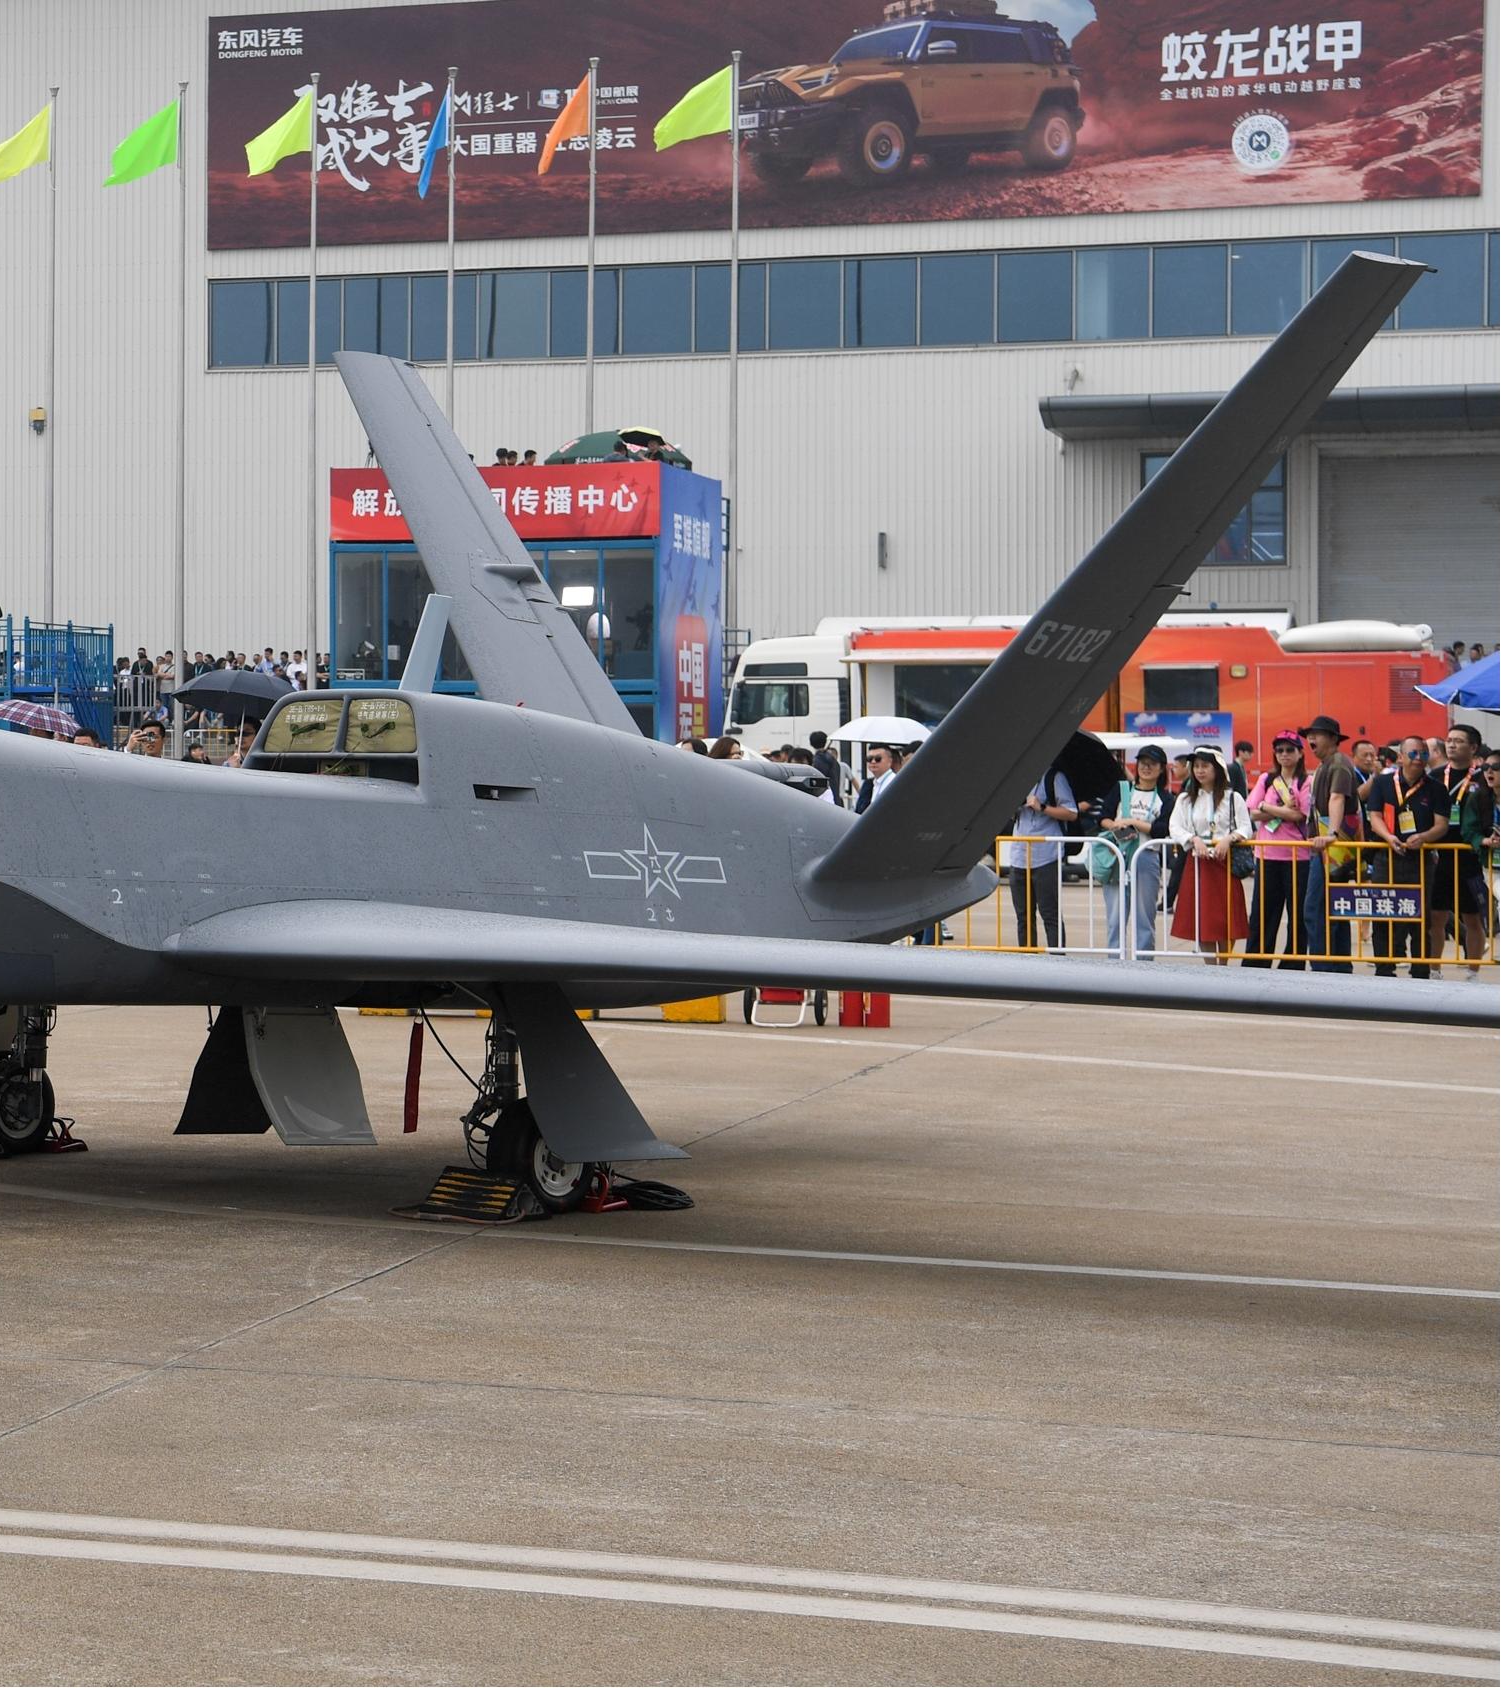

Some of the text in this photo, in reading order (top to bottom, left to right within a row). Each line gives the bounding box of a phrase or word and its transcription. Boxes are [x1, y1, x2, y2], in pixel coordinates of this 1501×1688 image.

[217, 26, 303, 50] 东风汽车
[218, 48, 303, 59] DONGFENG MOTOR
[1159, 20, 1362, 82] 蛟龙战甲
[1159, 77, 1362, 101] 全域机动的豪华电动越野座驾
[546, 126, 636, 152] 志凌云
[352, 483, 639, 517] 解放传播中心
[1024, 620, 1112, 662] 67182
[679, 640, 705, 698] 中国
[111, 888, 124, 905] 2
[1334, 897, 1416, 916] 中国珠海
[645, 907, 658, 922] 2
